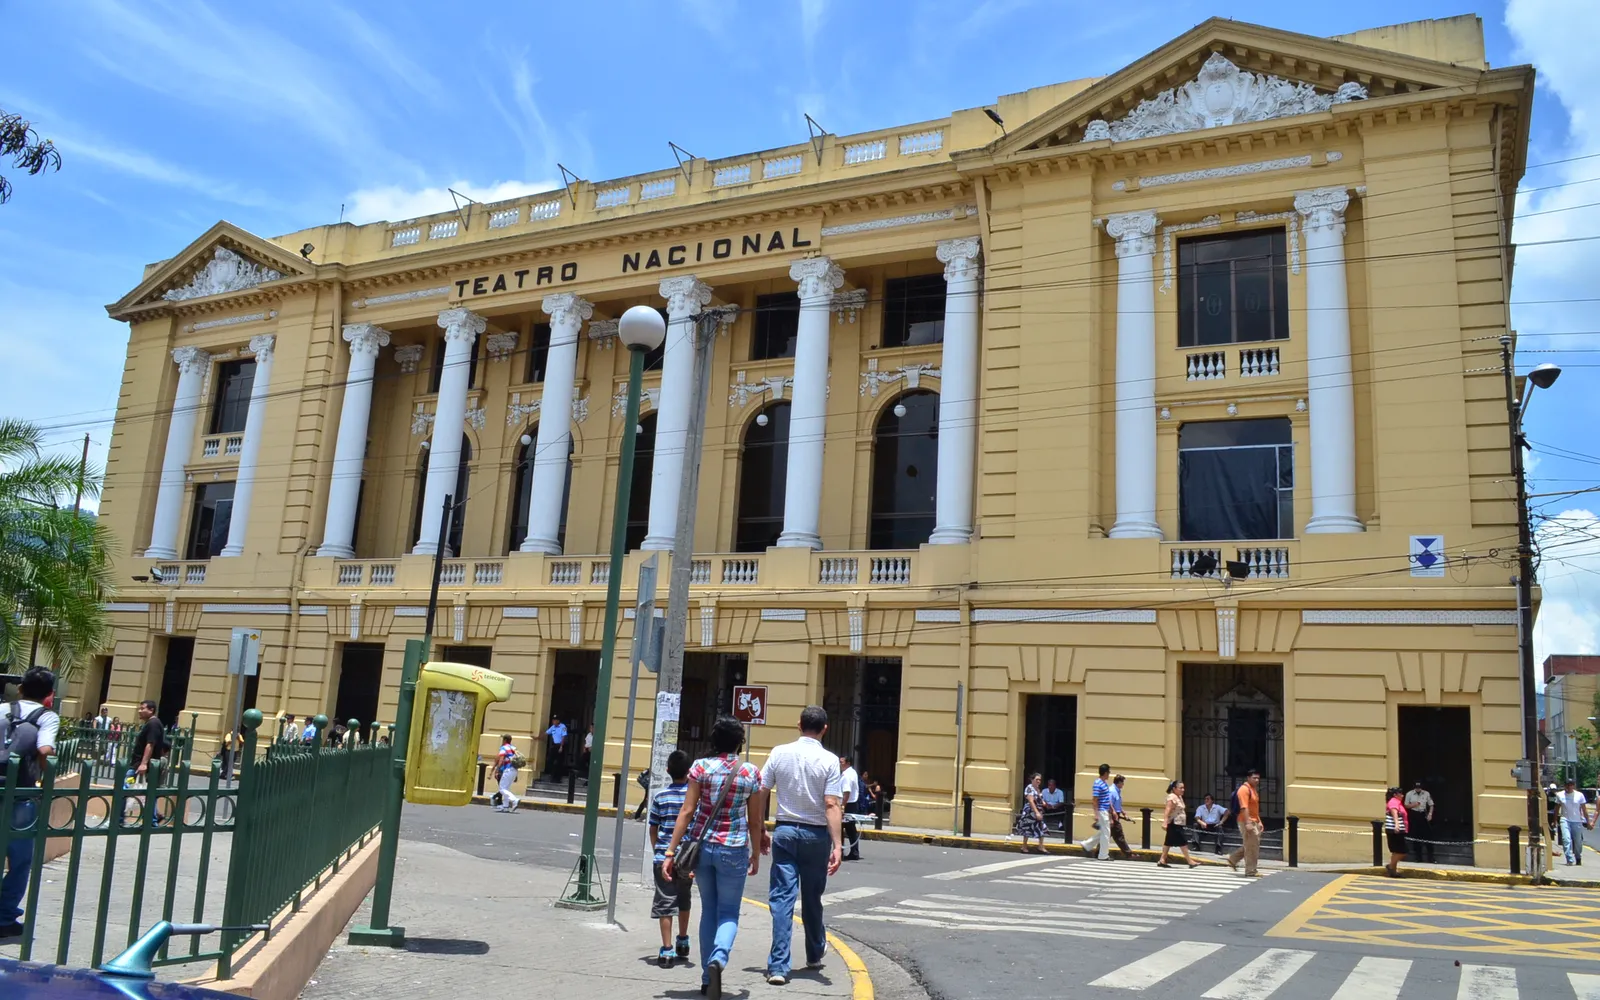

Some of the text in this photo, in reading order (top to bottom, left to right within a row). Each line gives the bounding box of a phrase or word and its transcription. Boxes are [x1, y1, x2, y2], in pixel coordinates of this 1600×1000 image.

[455, 227, 812, 298] TEATRO NACIONAL
[484, 673, 506, 682] telecom
